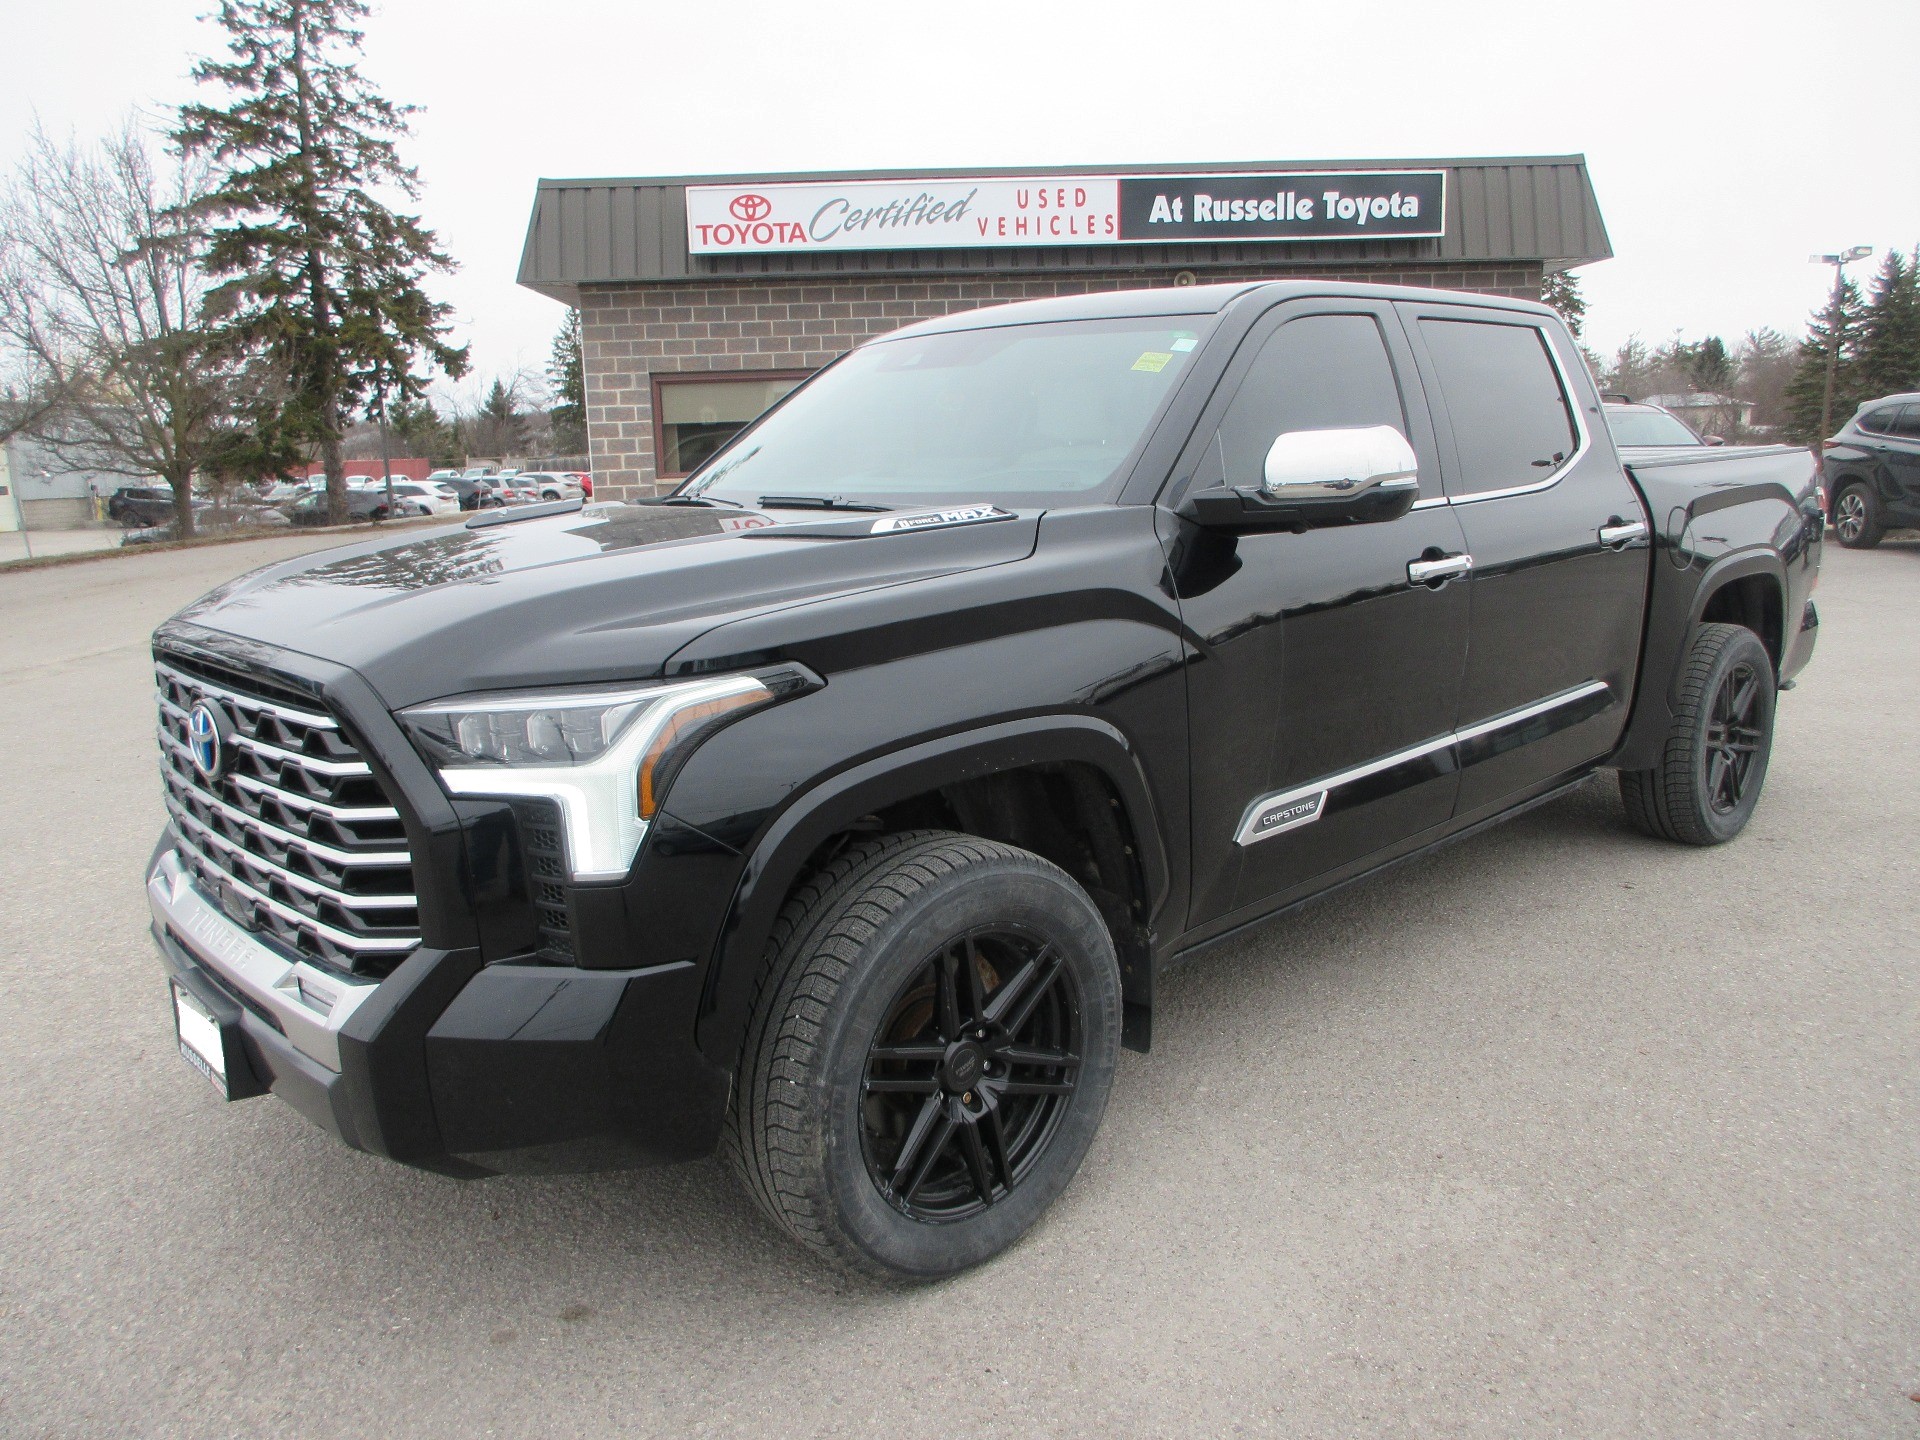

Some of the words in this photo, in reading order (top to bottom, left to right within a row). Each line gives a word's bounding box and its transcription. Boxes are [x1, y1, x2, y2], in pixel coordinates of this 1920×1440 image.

[1016, 187, 1086, 209] USED
[1149, 195, 1183, 223] At
[1193, 191, 1314, 223] Russelle
[1323, 191, 1419, 226] Toyota
[695, 222, 808, 246] TOYOTA
[808, 187, 978, 243] Certified
[976, 213, 1115, 238] VEHICLES
[940, 505, 998, 522] MAX
[1262, 800, 1316, 825] CAPSTONE
